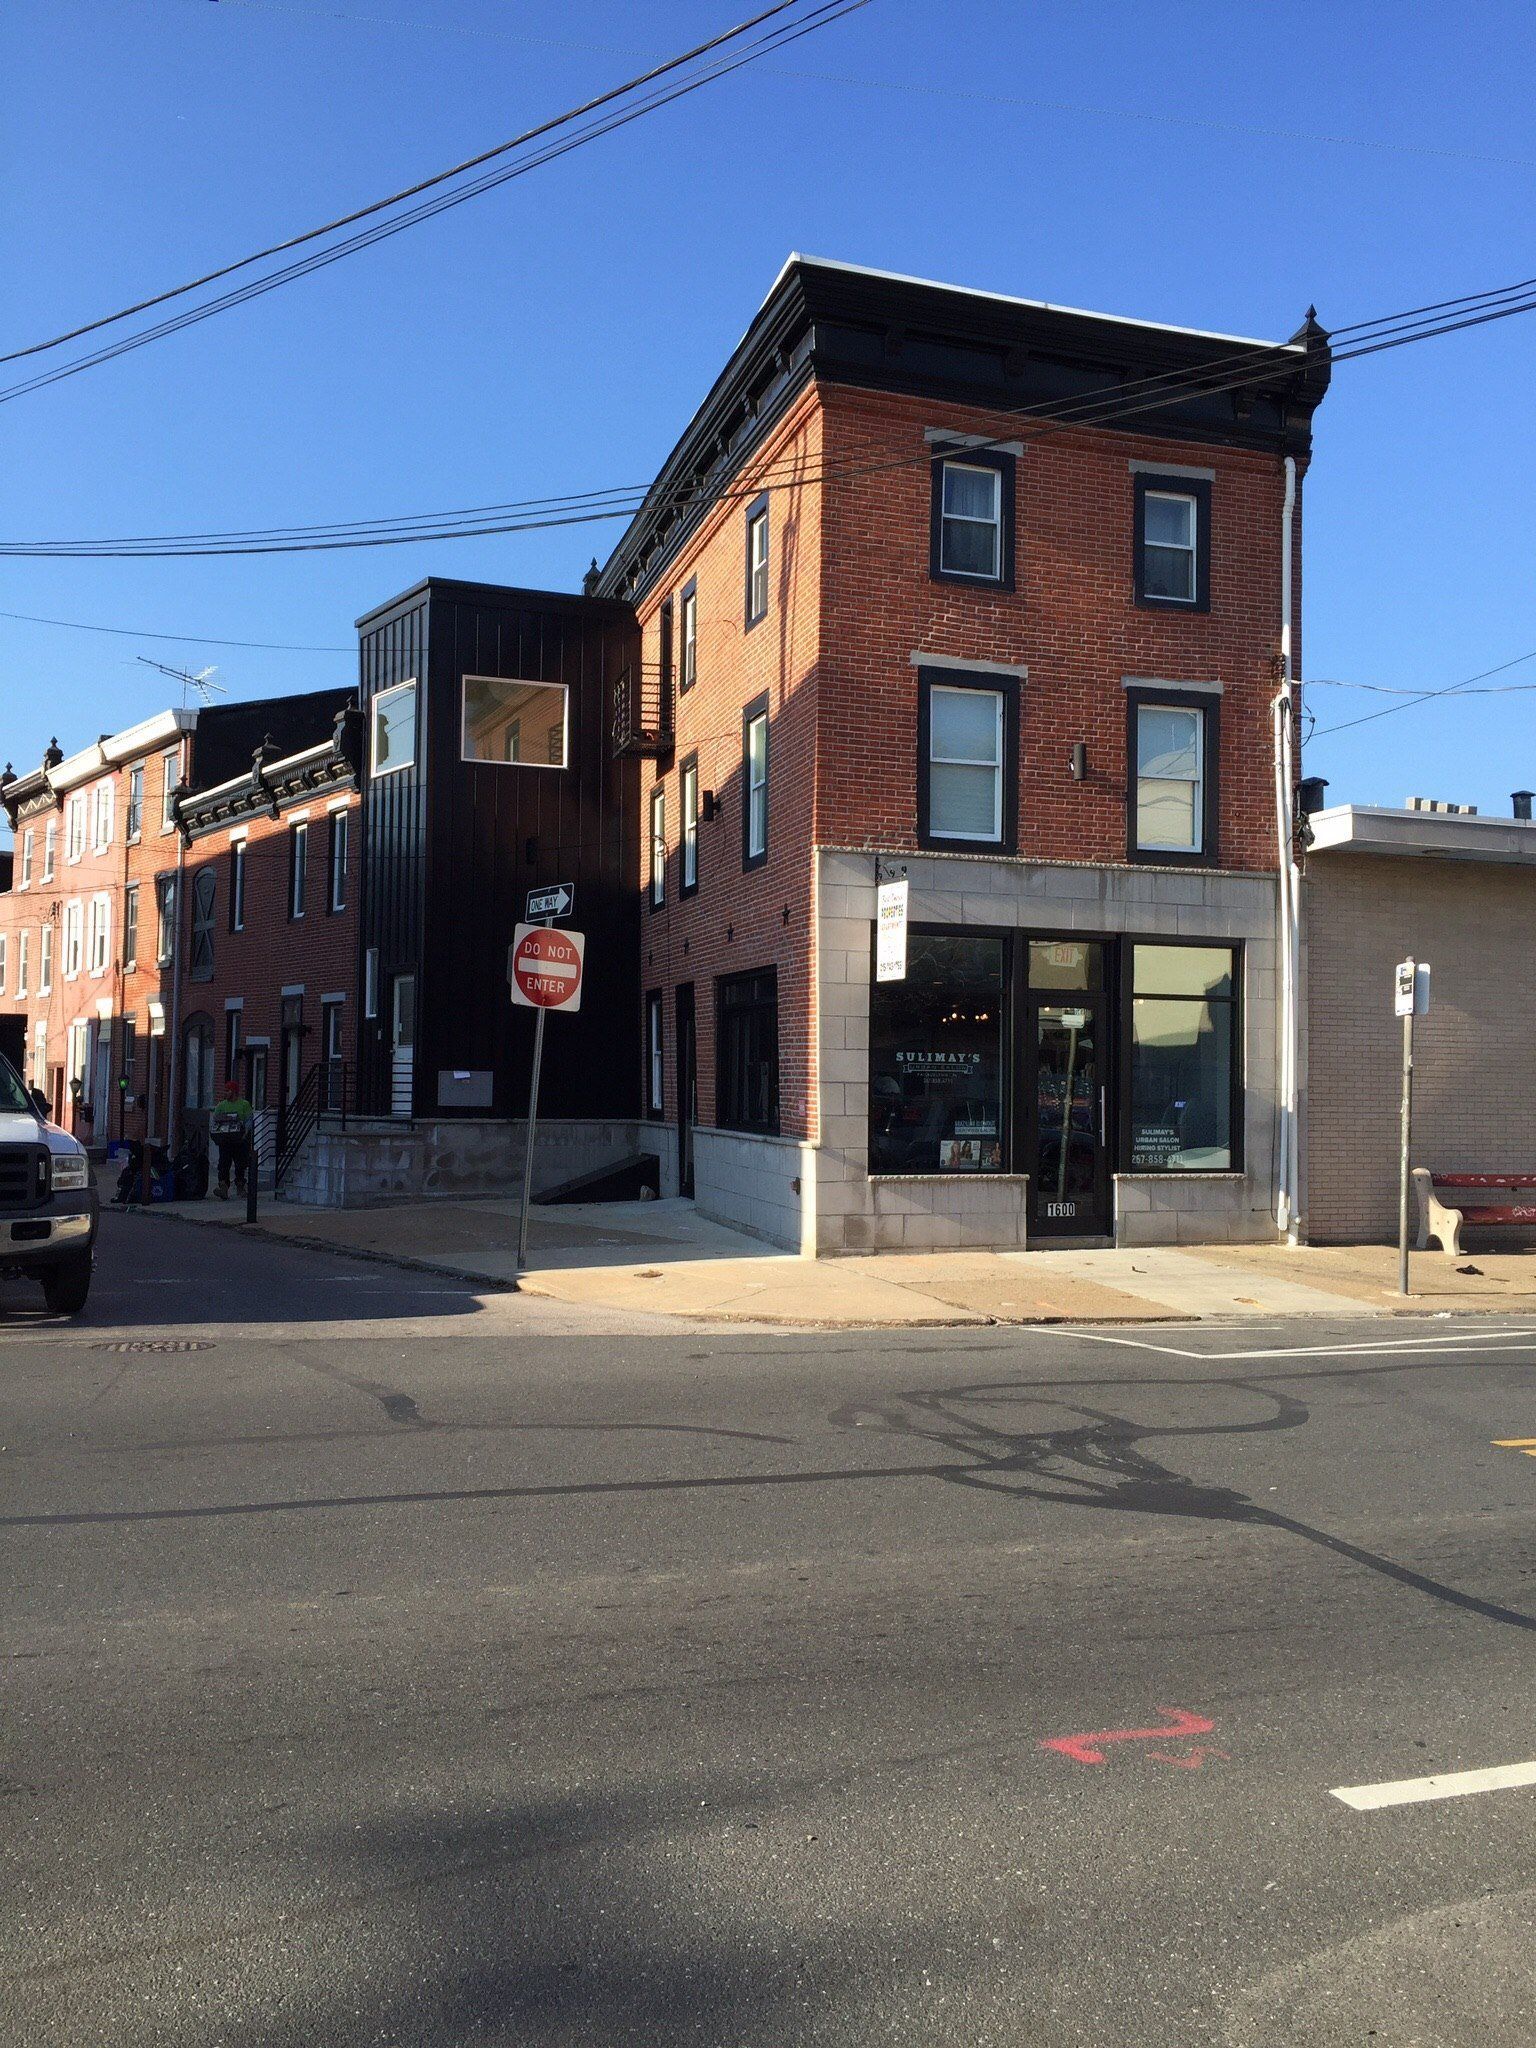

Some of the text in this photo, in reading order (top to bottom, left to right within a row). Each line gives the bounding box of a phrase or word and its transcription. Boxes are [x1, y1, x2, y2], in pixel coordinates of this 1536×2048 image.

[531, 896, 559, 912] ONE WAY
[524, 941, 573, 960] DO NOT
[1054, 946, 1074, 964] EXIT
[526, 977, 565, 994] ENTER
[895, 1051, 981, 1063] SULIMAY'S
[1049, 1203, 1074, 1216] 1600
